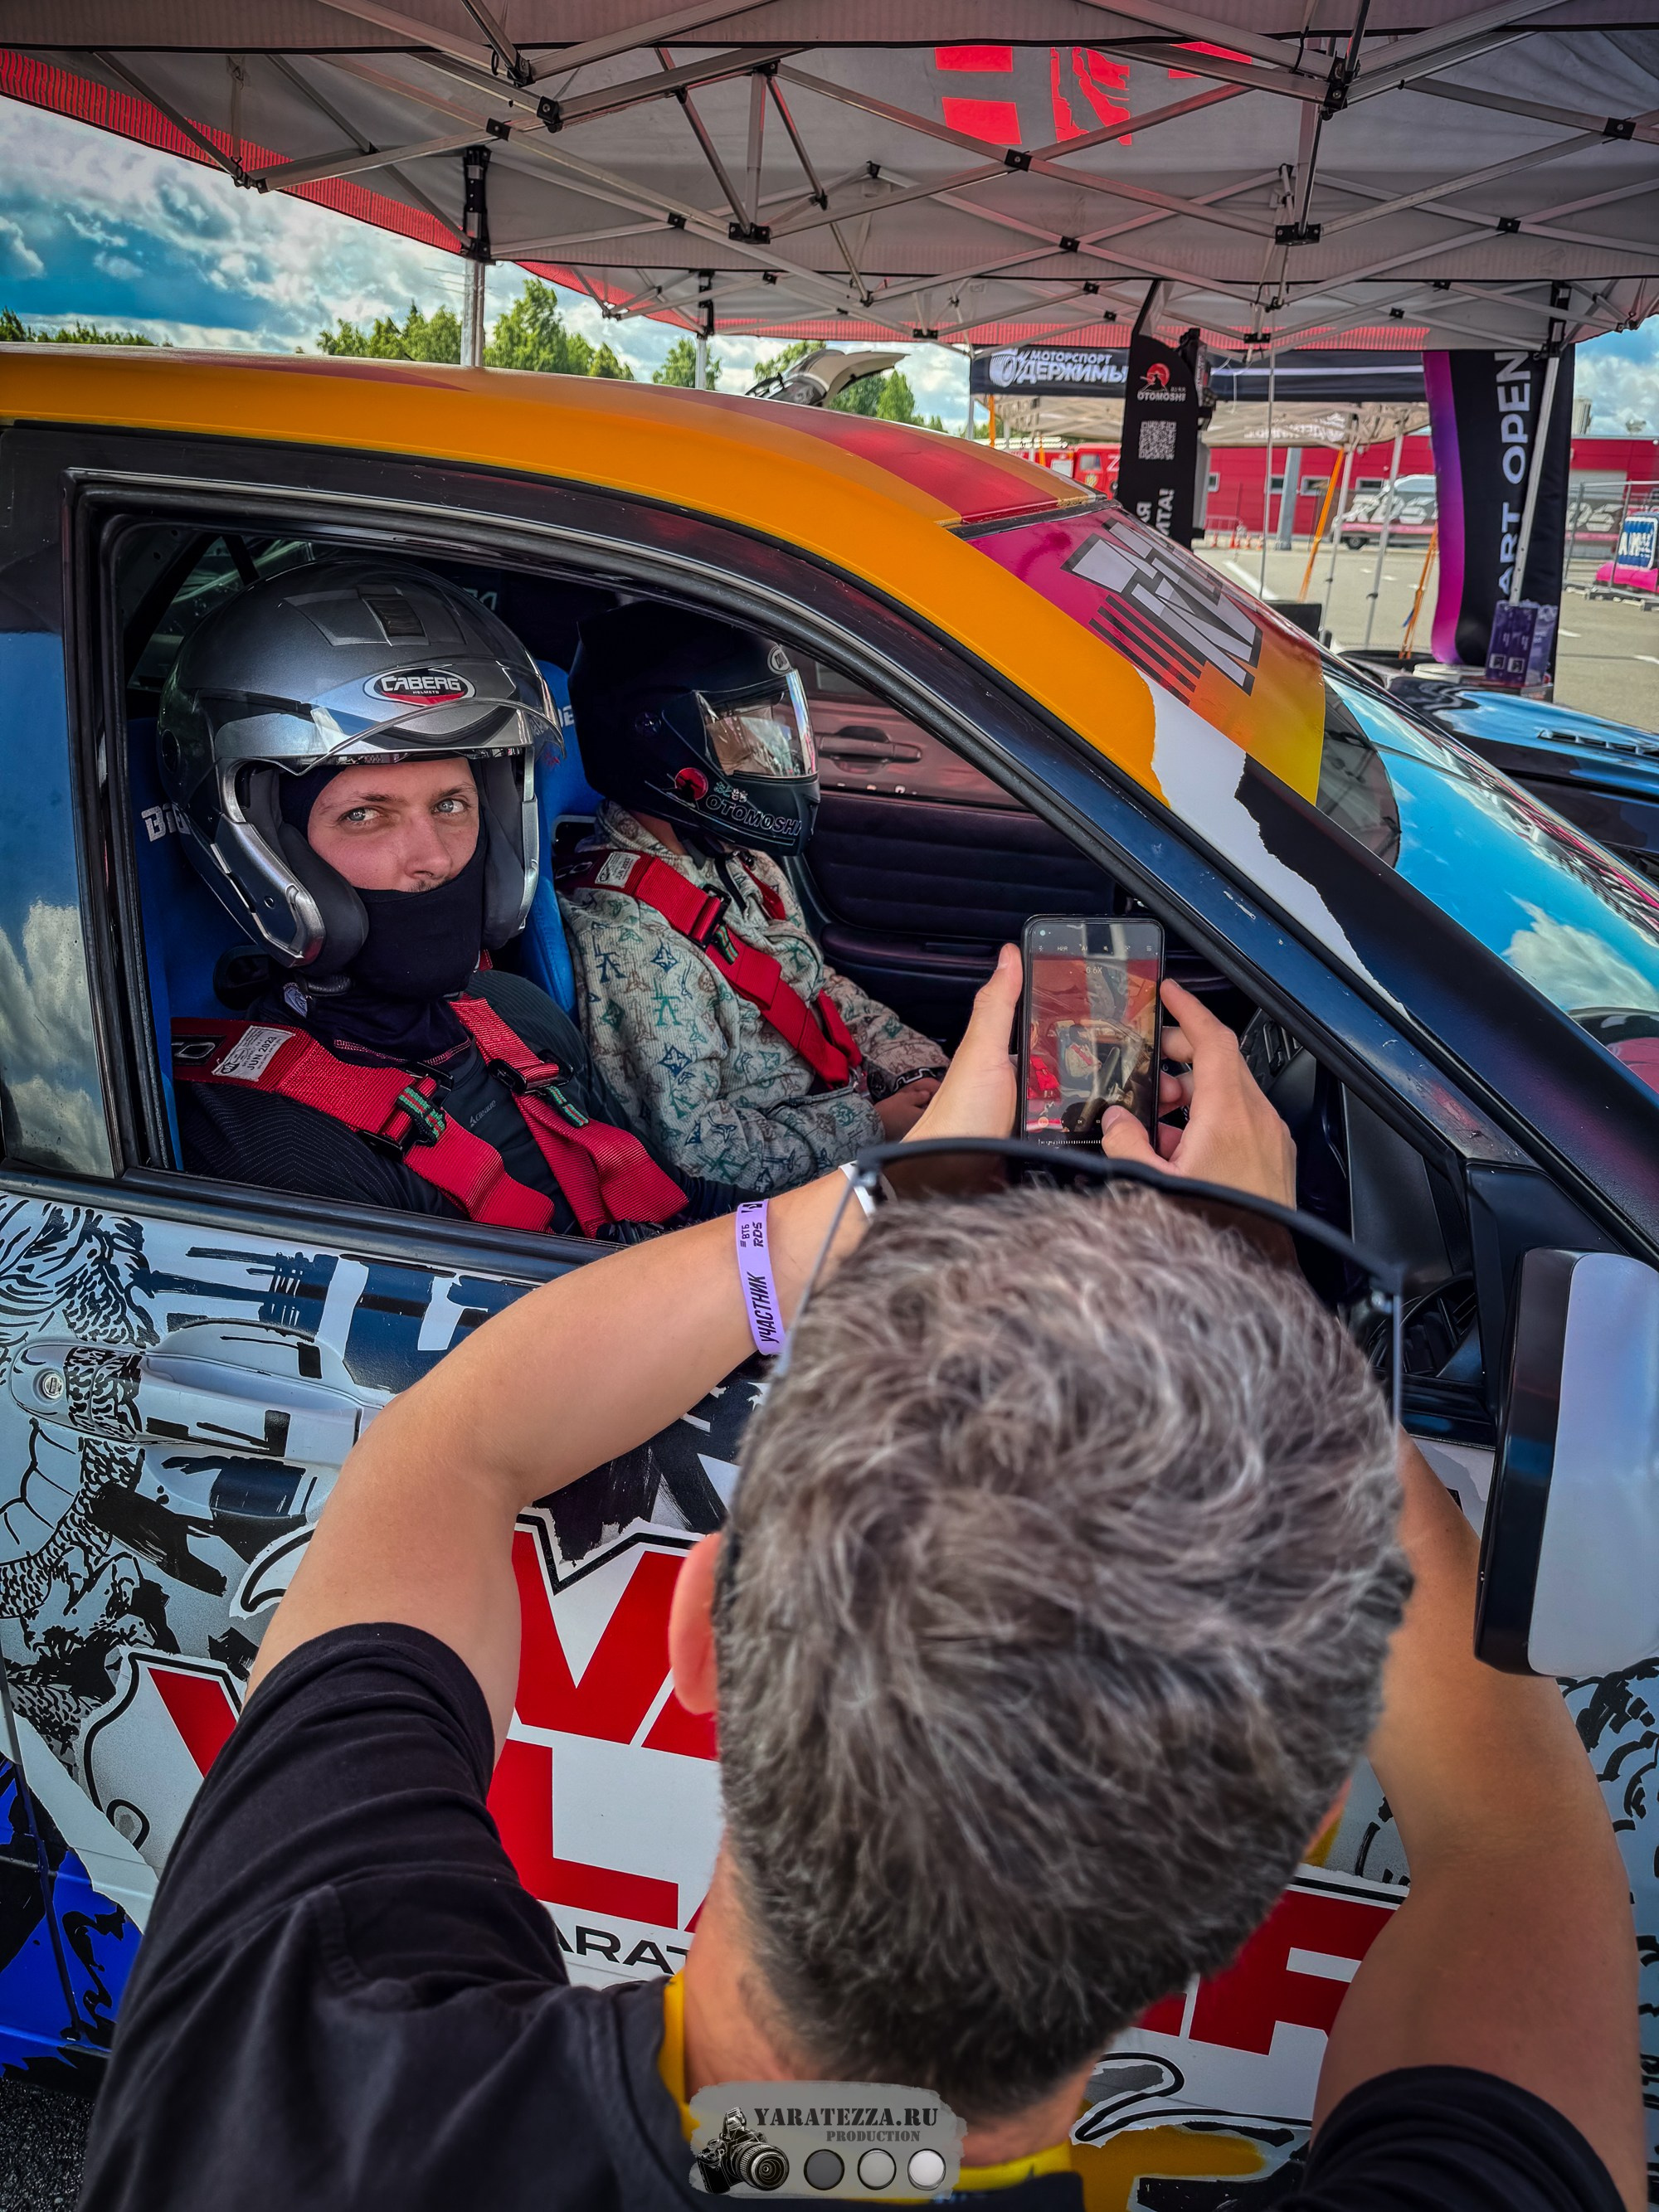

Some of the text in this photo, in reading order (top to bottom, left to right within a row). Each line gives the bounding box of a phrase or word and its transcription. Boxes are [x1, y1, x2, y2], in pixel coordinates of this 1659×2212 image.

[1029, 349, 1112, 364] МОТОРСПОРТ
[1136, 391, 1186, 402] OTOMOSHI
[1495, 351, 1531, 484] OPEN
[381, 676, 462, 692] CABERG
[705, 794, 803, 837] OTOMOSHI
[247, 1053, 264, 1070] JUN
[752, 1222, 764, 1247] RDS
[747, 1271, 780, 1344] УЧАСТНИК
